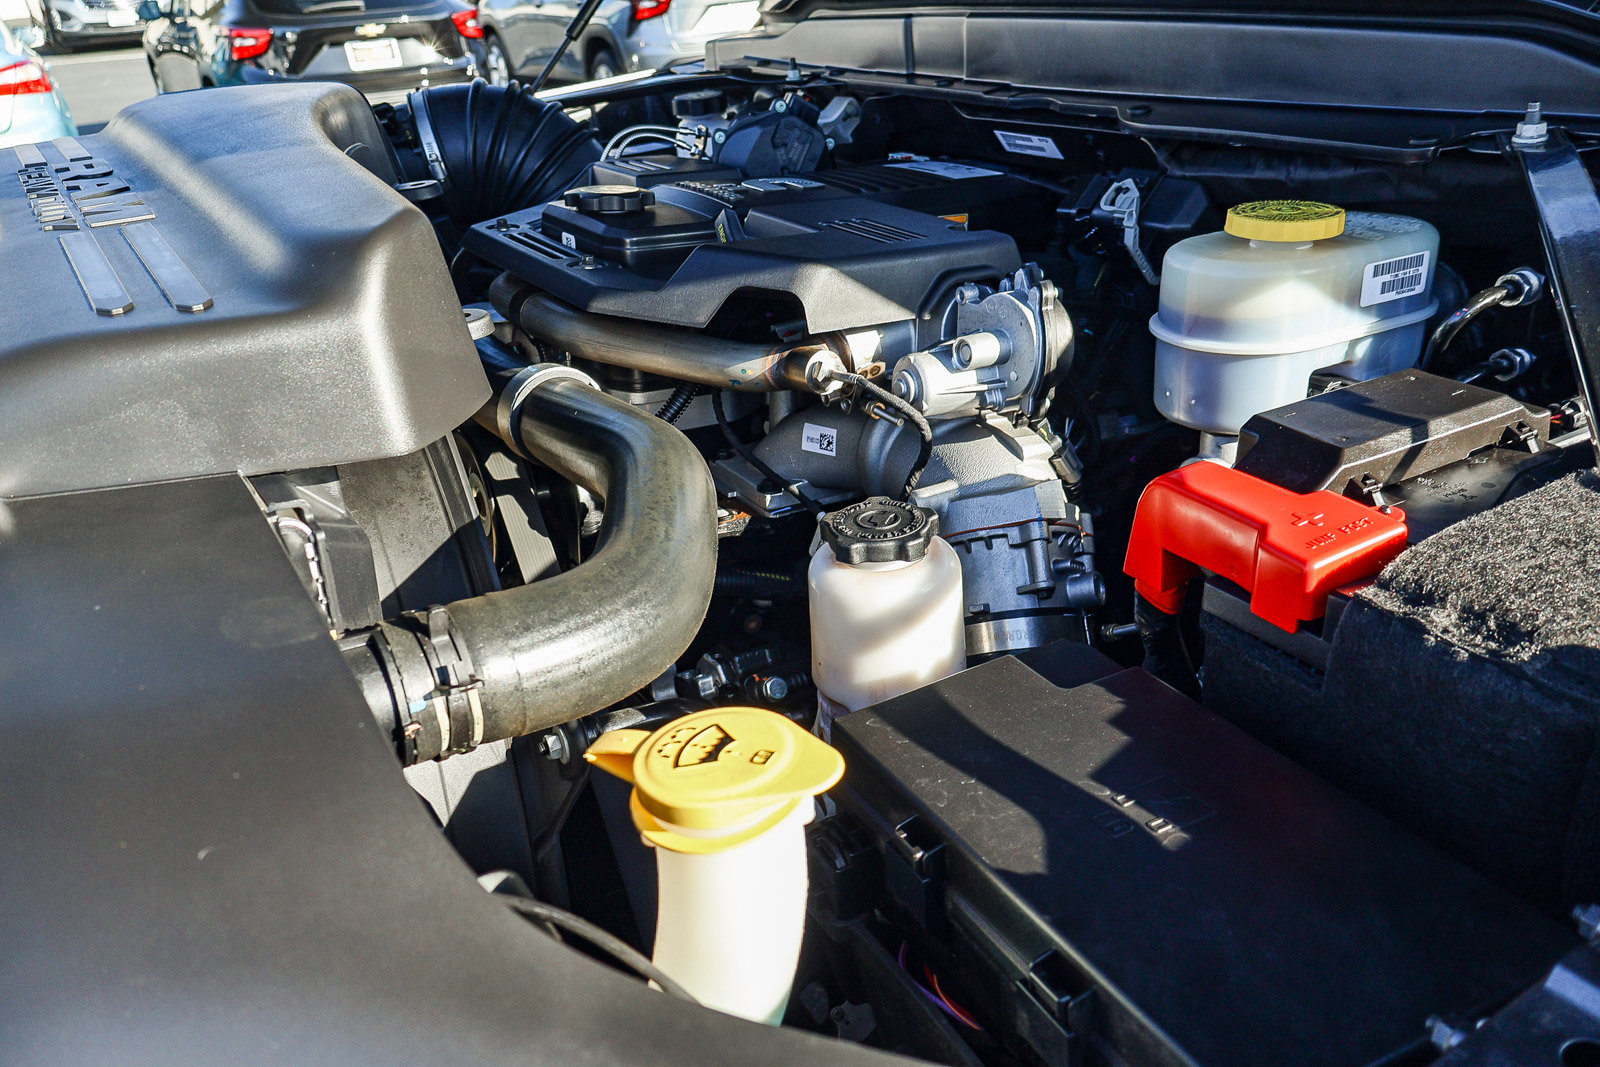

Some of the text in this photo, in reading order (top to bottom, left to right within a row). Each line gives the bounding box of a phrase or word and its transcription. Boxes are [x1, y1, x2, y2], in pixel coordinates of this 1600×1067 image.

[17, 167, 81, 231] HEAVY DUTY
[52, 158, 156, 228] RAM
[1338, 516, 1374, 534] POST
